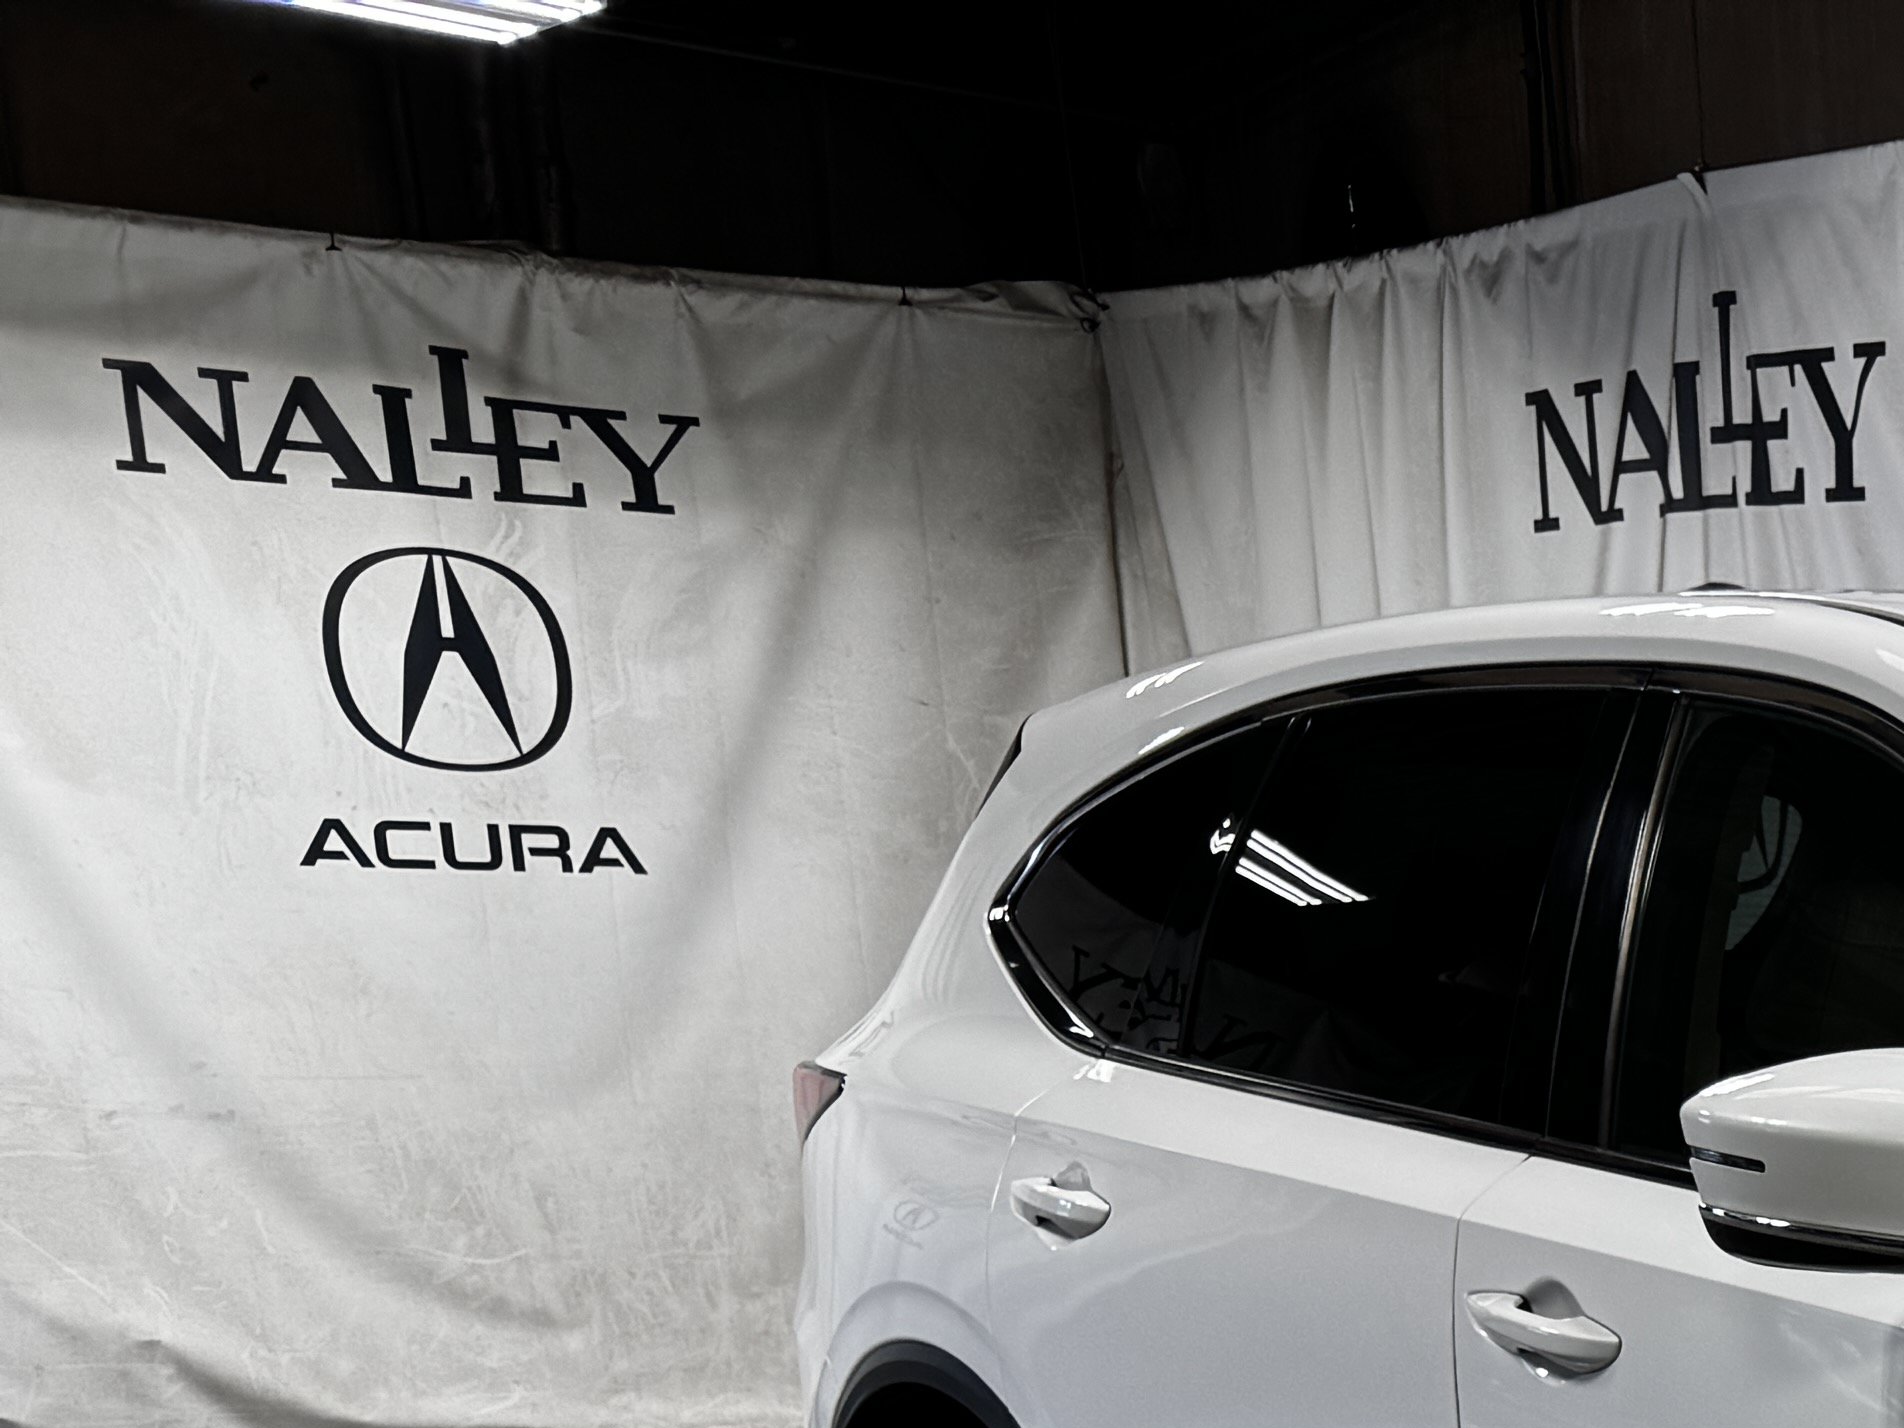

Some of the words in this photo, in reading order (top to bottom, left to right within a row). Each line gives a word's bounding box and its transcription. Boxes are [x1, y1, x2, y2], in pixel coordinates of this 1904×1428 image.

[101, 345, 700, 515] NALLEY
[1524, 290, 1886, 533] NALLEY
[300, 818, 648, 875] ACURA
